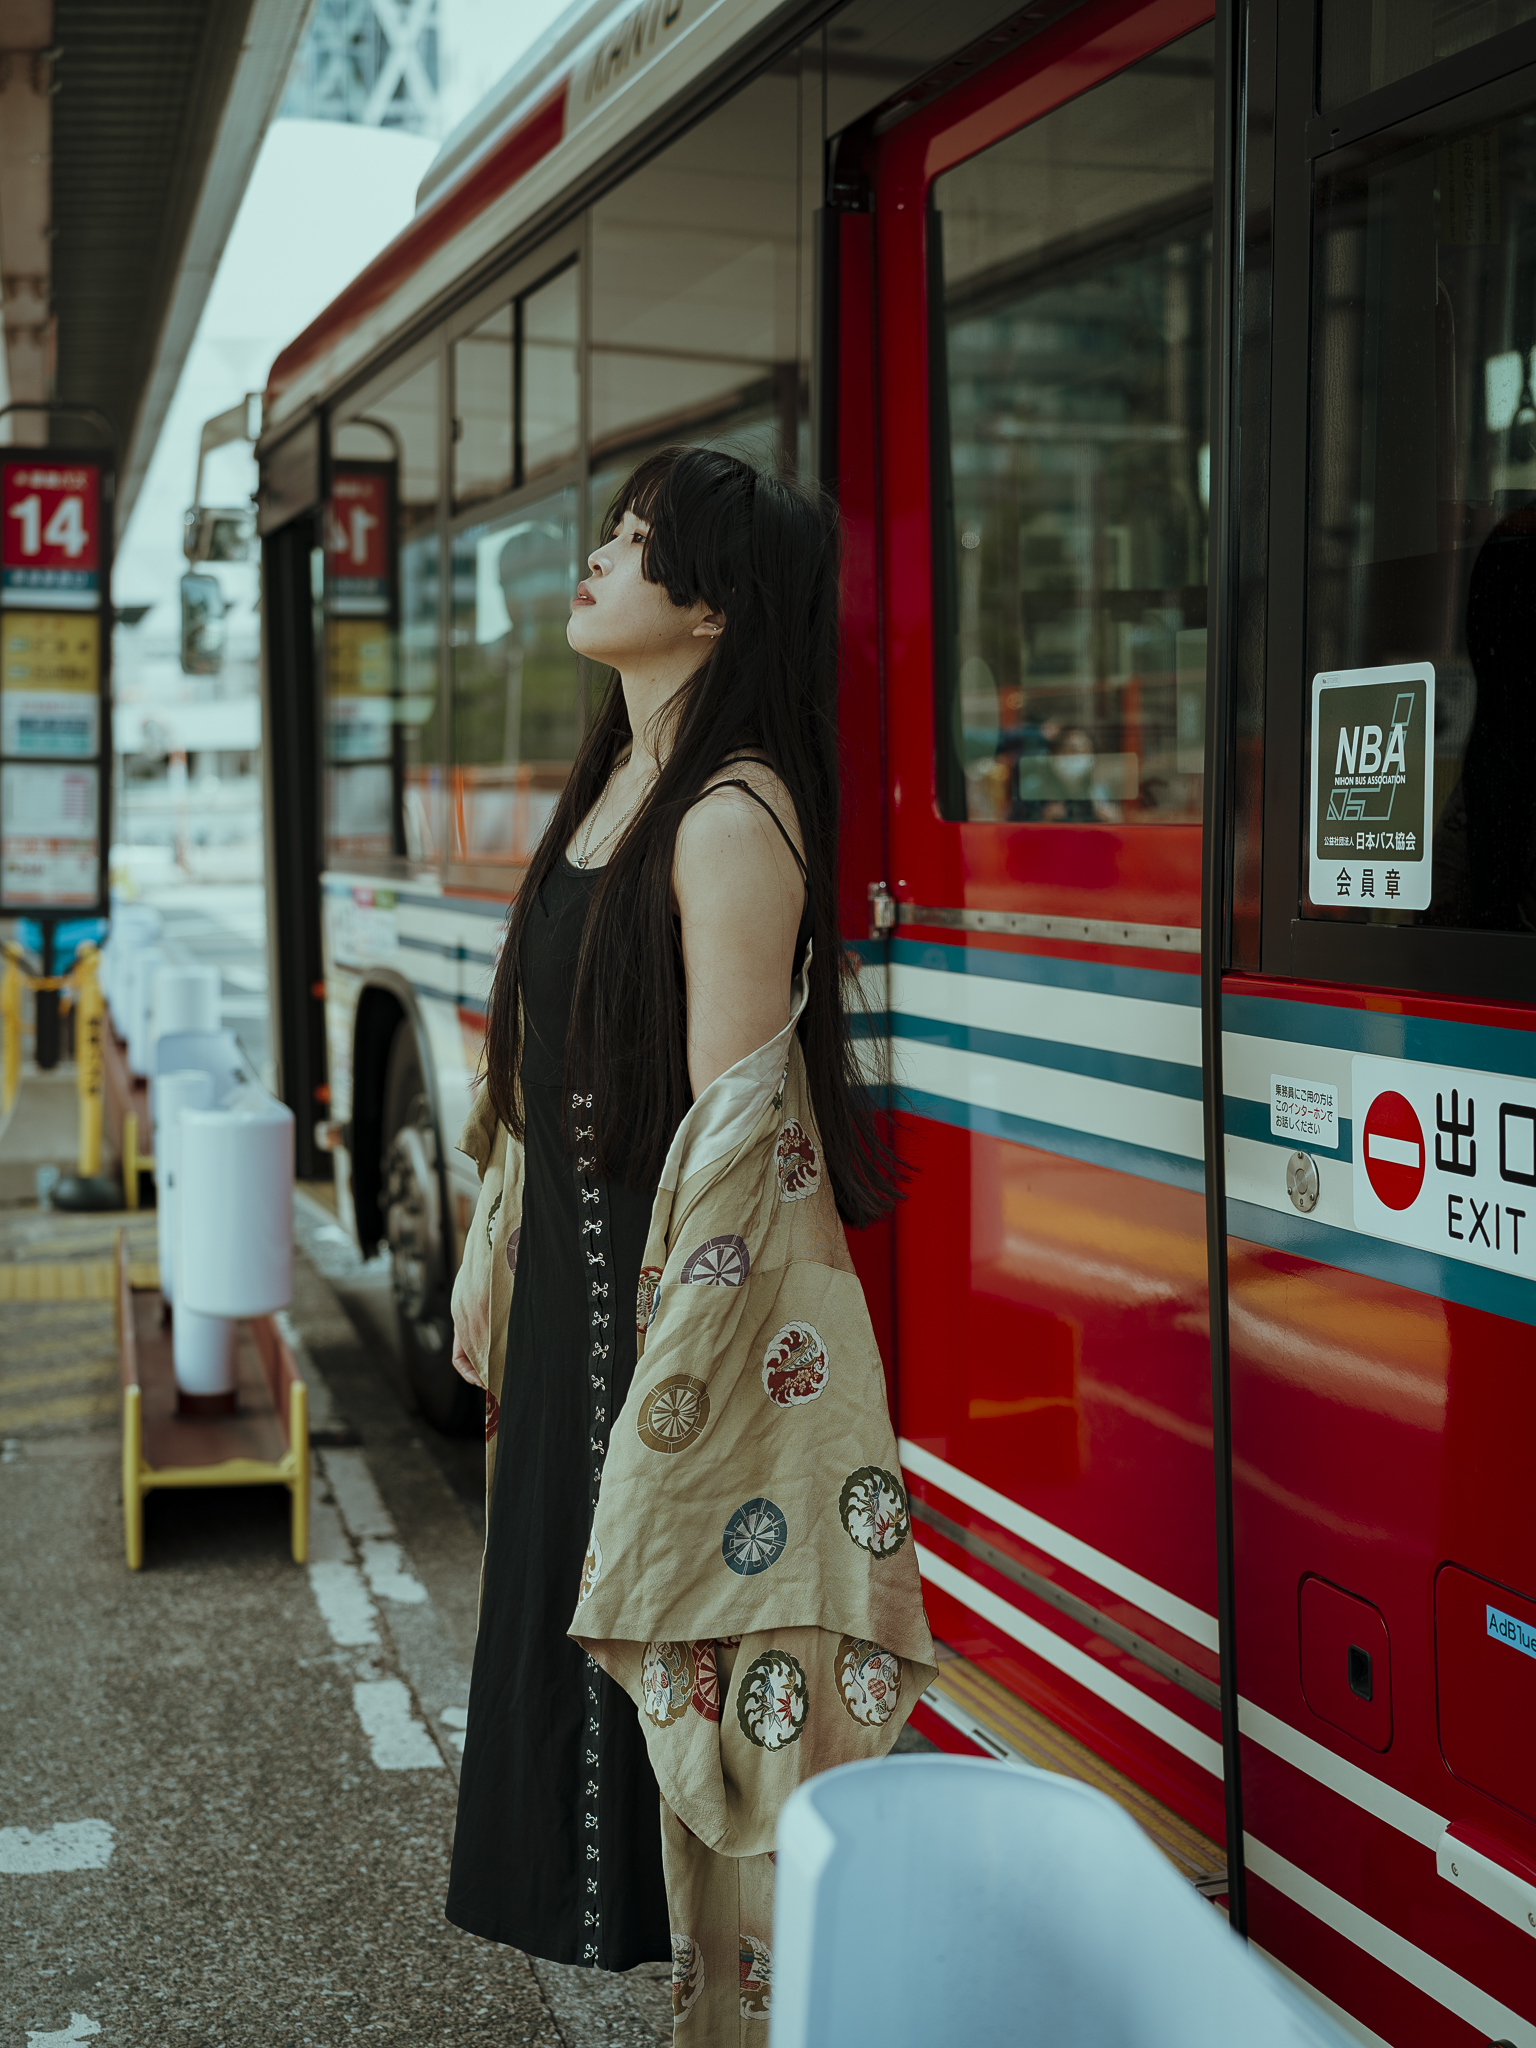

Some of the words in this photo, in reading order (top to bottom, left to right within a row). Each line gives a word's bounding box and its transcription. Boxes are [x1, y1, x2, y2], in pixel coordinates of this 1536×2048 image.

[1463, 136, 1476, 241] 立たないで下さい
[8, 494, 89, 559] 14
[1334, 723, 1406, 775] NBA
[1334, 776, 1354, 786] NIHON
[1355, 776, 1366, 785] BUS
[1367, 775, 1406, 785] ASSOCIATION
[1324, 836, 1354, 847] 公益社団法人
[1356, 831, 1416, 851] 日本バス協会
[1336, 866, 1401, 899] 会員章
[1275, 1083, 1333, 1107] 乗務員にご用の方は
[1275, 1099, 1333, 1123] このインターホンで
[1275, 1115, 1321, 1135] お話しください
[1434, 1088, 1536, 1188] 出口
[1447, 1193, 1526, 1255] EXIT
[1489, 1613, 1536, 1653] AdBlue
